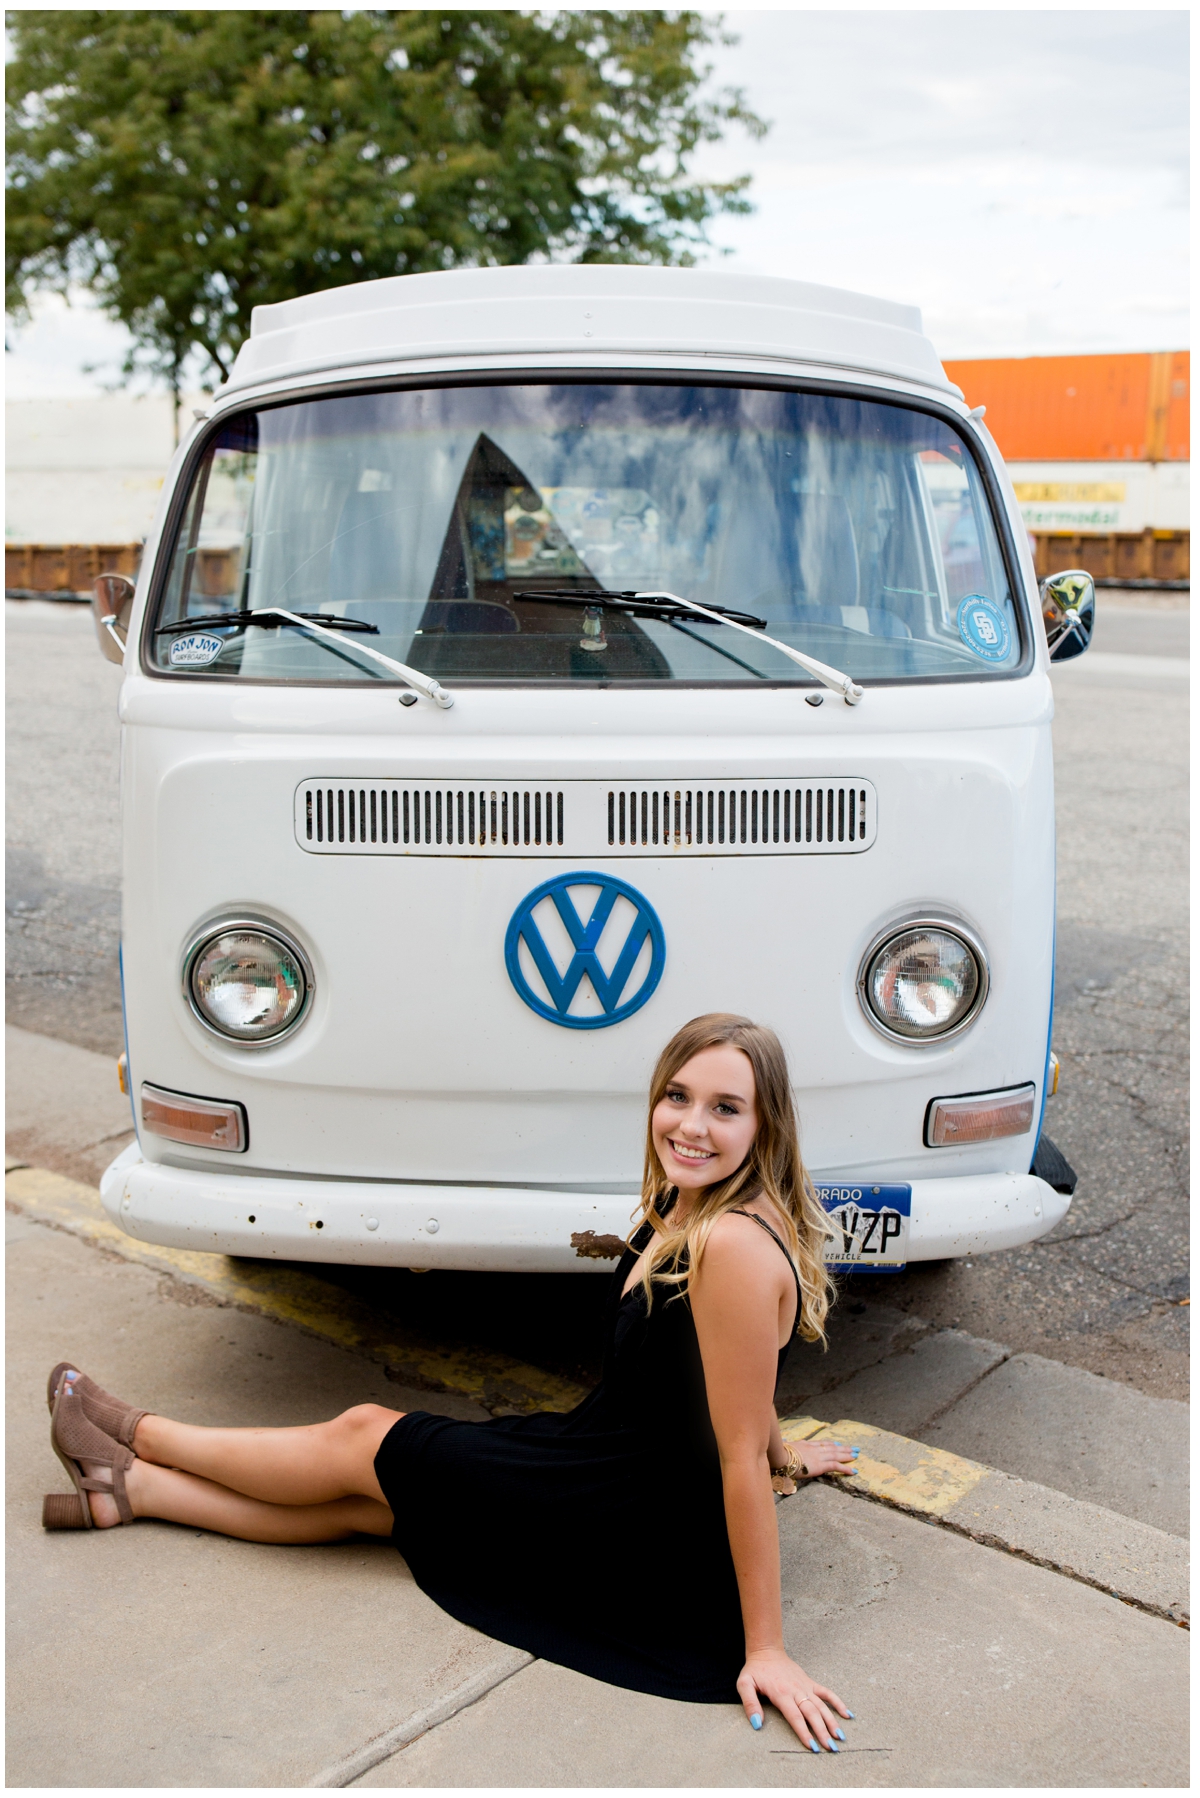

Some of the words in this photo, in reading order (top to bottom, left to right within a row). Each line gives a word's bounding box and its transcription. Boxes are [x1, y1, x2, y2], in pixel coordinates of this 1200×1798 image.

[1023, 507, 1120, 524] termodal
[172, 637, 195, 654] RON
[196, 638, 219, 653] JON
[518, 885, 651, 1016] VW
[814, 1188, 863, 1201] ORADO
